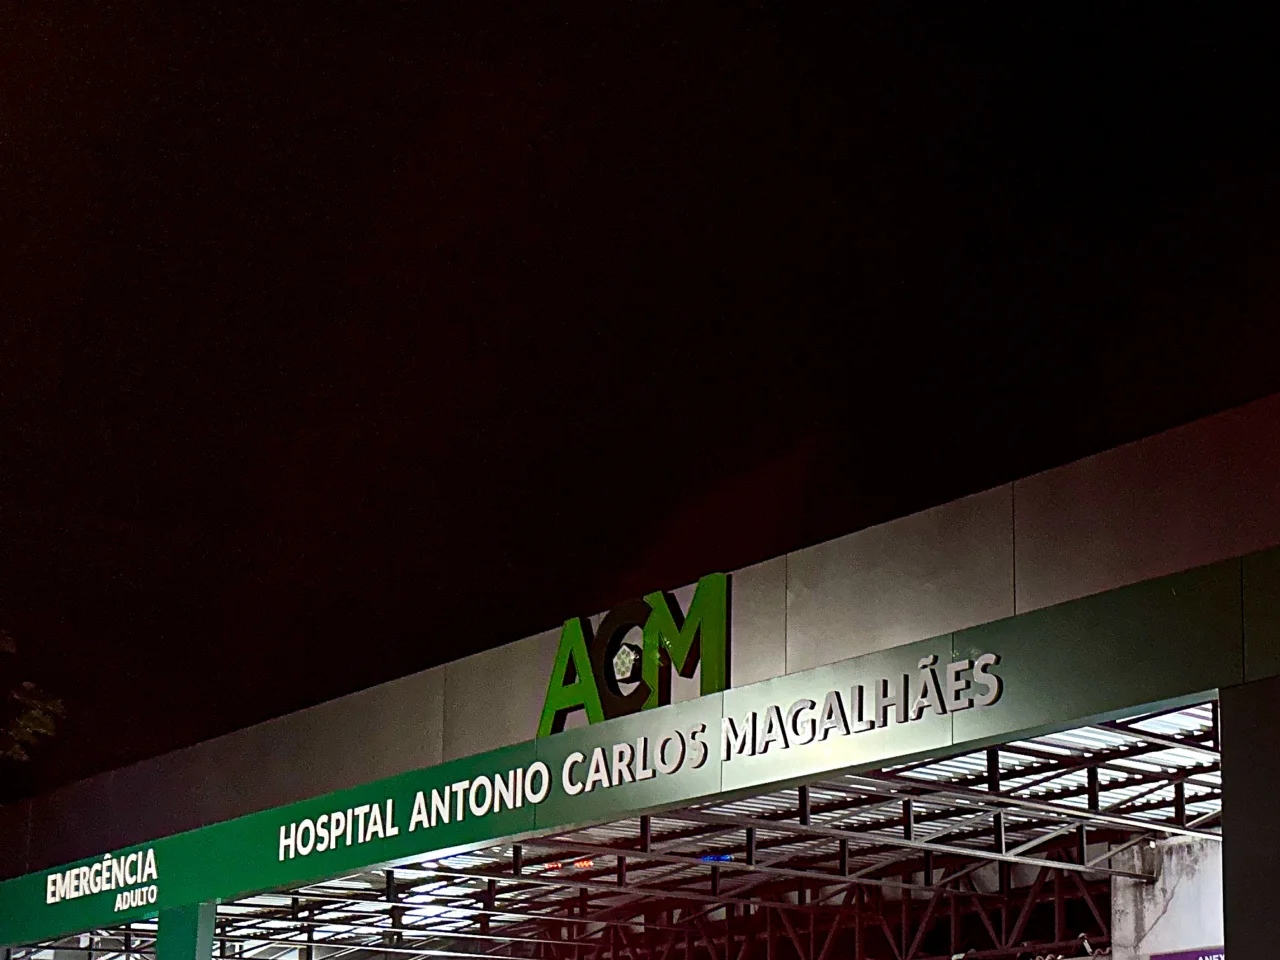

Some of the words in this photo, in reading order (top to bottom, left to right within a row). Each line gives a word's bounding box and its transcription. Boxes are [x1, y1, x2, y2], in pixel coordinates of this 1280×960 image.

[537, 572, 731, 738] ACM
[278, 798, 399, 861] HOSPITAL
[408, 761, 551, 832] ANTONIO
[562, 722, 707, 795] CARLOS
[720, 652, 1002, 761] MAGALHÃES
[46, 848, 158, 904] EMERGÊNCIA
[113, 884, 158, 912] ADULTO
